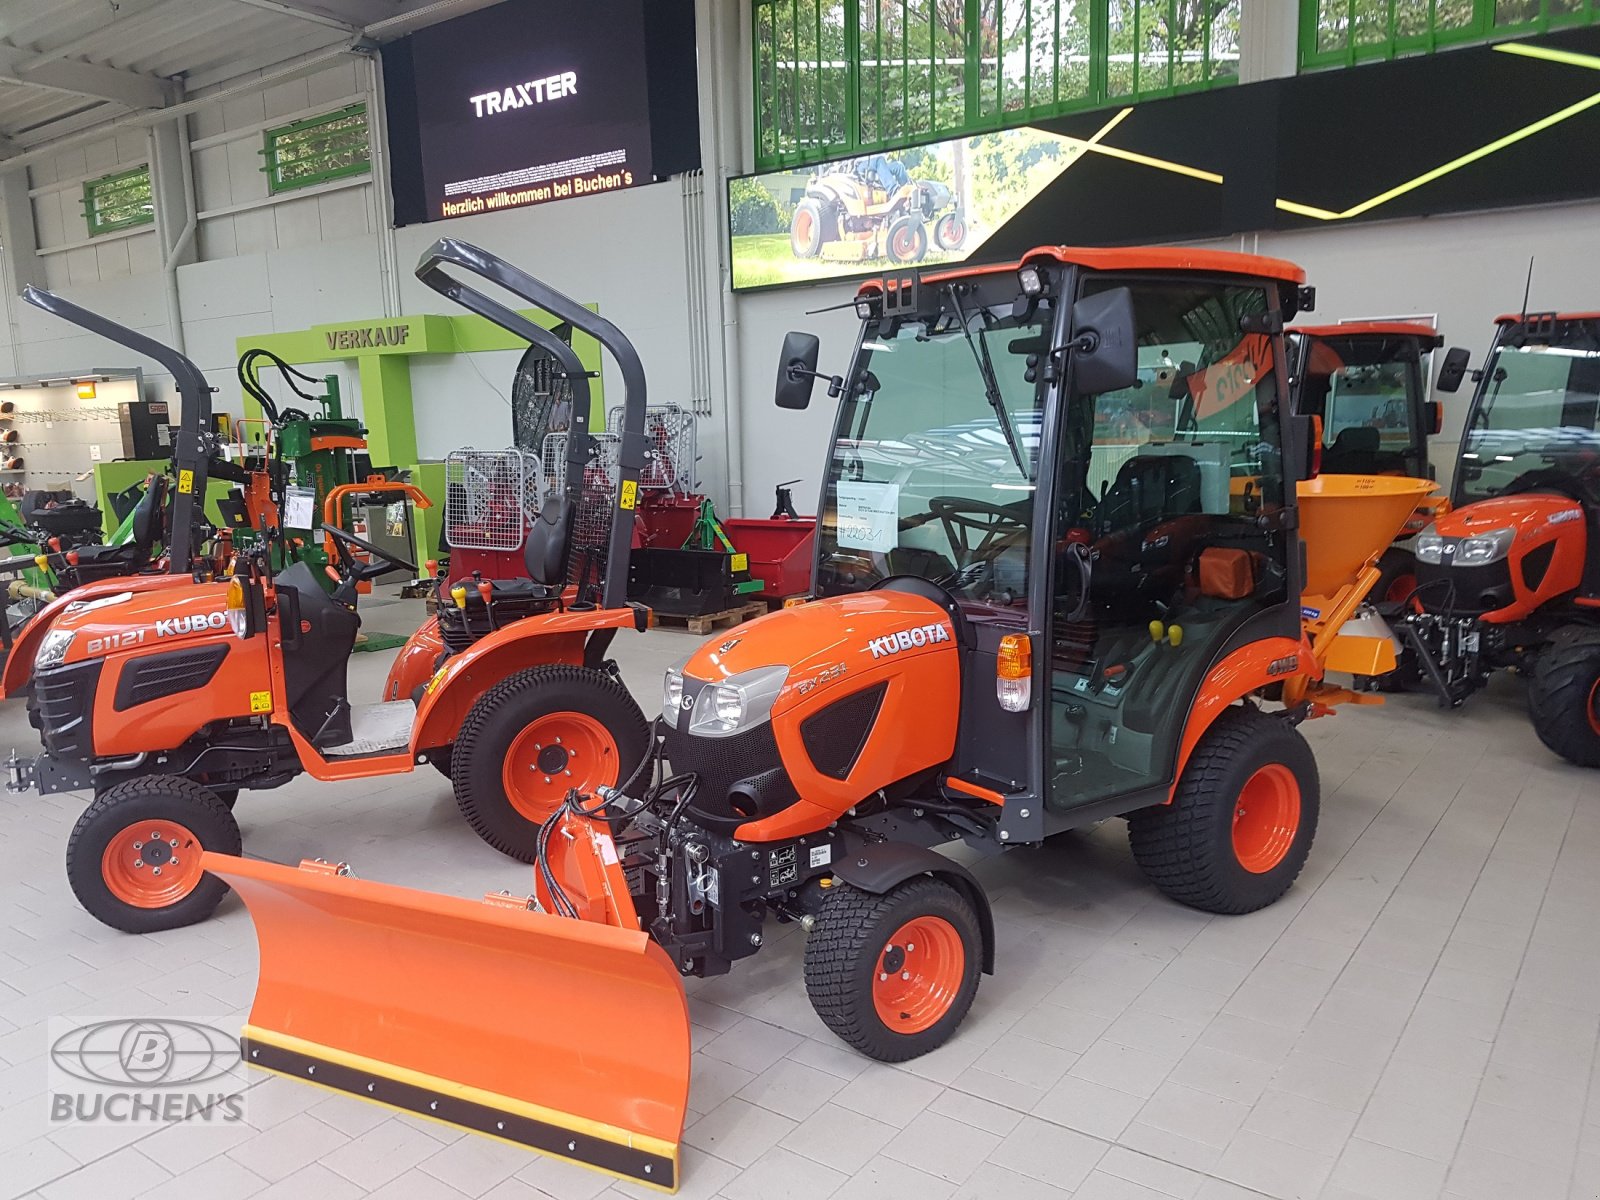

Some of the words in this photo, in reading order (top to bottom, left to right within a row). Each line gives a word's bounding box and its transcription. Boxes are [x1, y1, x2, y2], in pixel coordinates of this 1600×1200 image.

[469, 71, 577, 118] TRAXTER
[442, 196, 484, 216] Herzlich
[486, 186, 551, 208] willkommen
[554, 180, 572, 197] bei
[326, 324, 409, 350] VERKAUF
[87, 629, 145, 654] B1121
[868, 623, 950, 659] KUBOTA
[1267, 655, 1297, 676] 4WD
